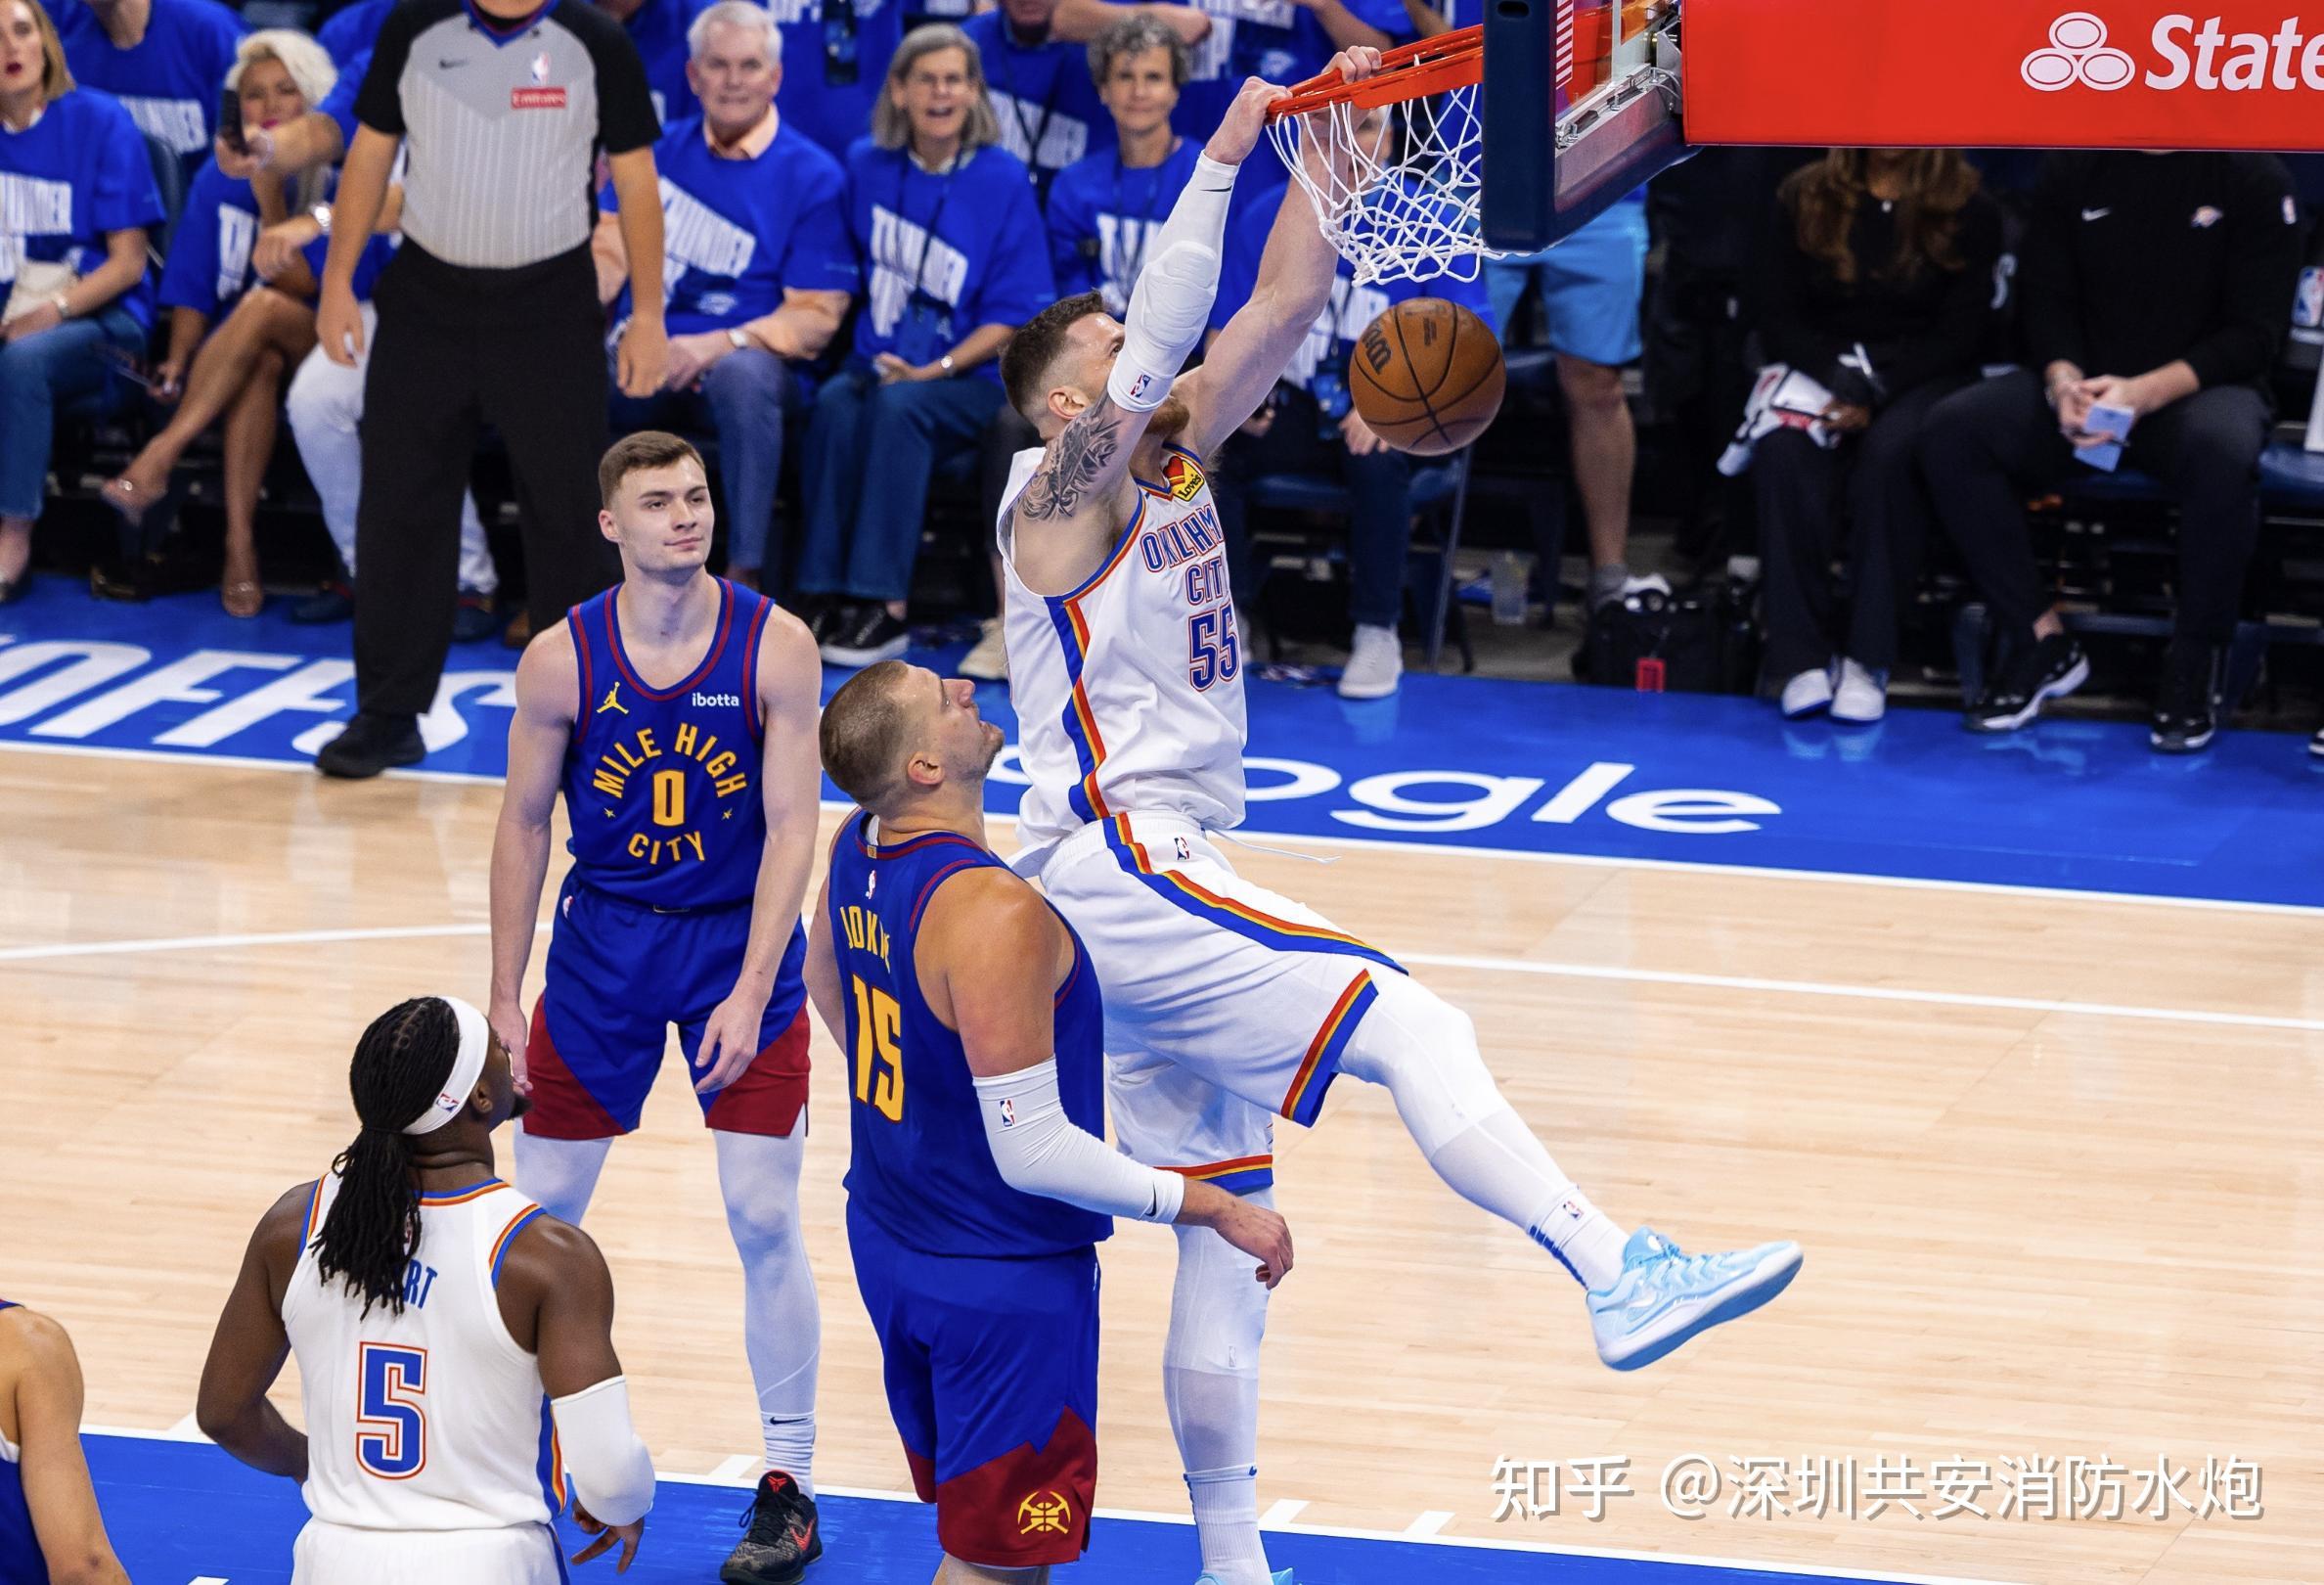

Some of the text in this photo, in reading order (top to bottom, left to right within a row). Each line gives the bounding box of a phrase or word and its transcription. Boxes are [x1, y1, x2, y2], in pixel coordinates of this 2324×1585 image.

[2145, 14, 2324, 91] State
[1177, 473, 1202, 499] Love's
[1185, 555, 1225, 606] CIT
[1188, 601, 1239, 693] 55
[692, 692, 739, 706] ibotta
[593, 722, 747, 799] MILE HIGH
[652, 769, 685, 827] 0
[627, 831, 705, 865] CITY
[851, 972, 905, 1122] 15
[400, 1258, 438, 1309] RT
[356, 1341, 427, 1480] 5
